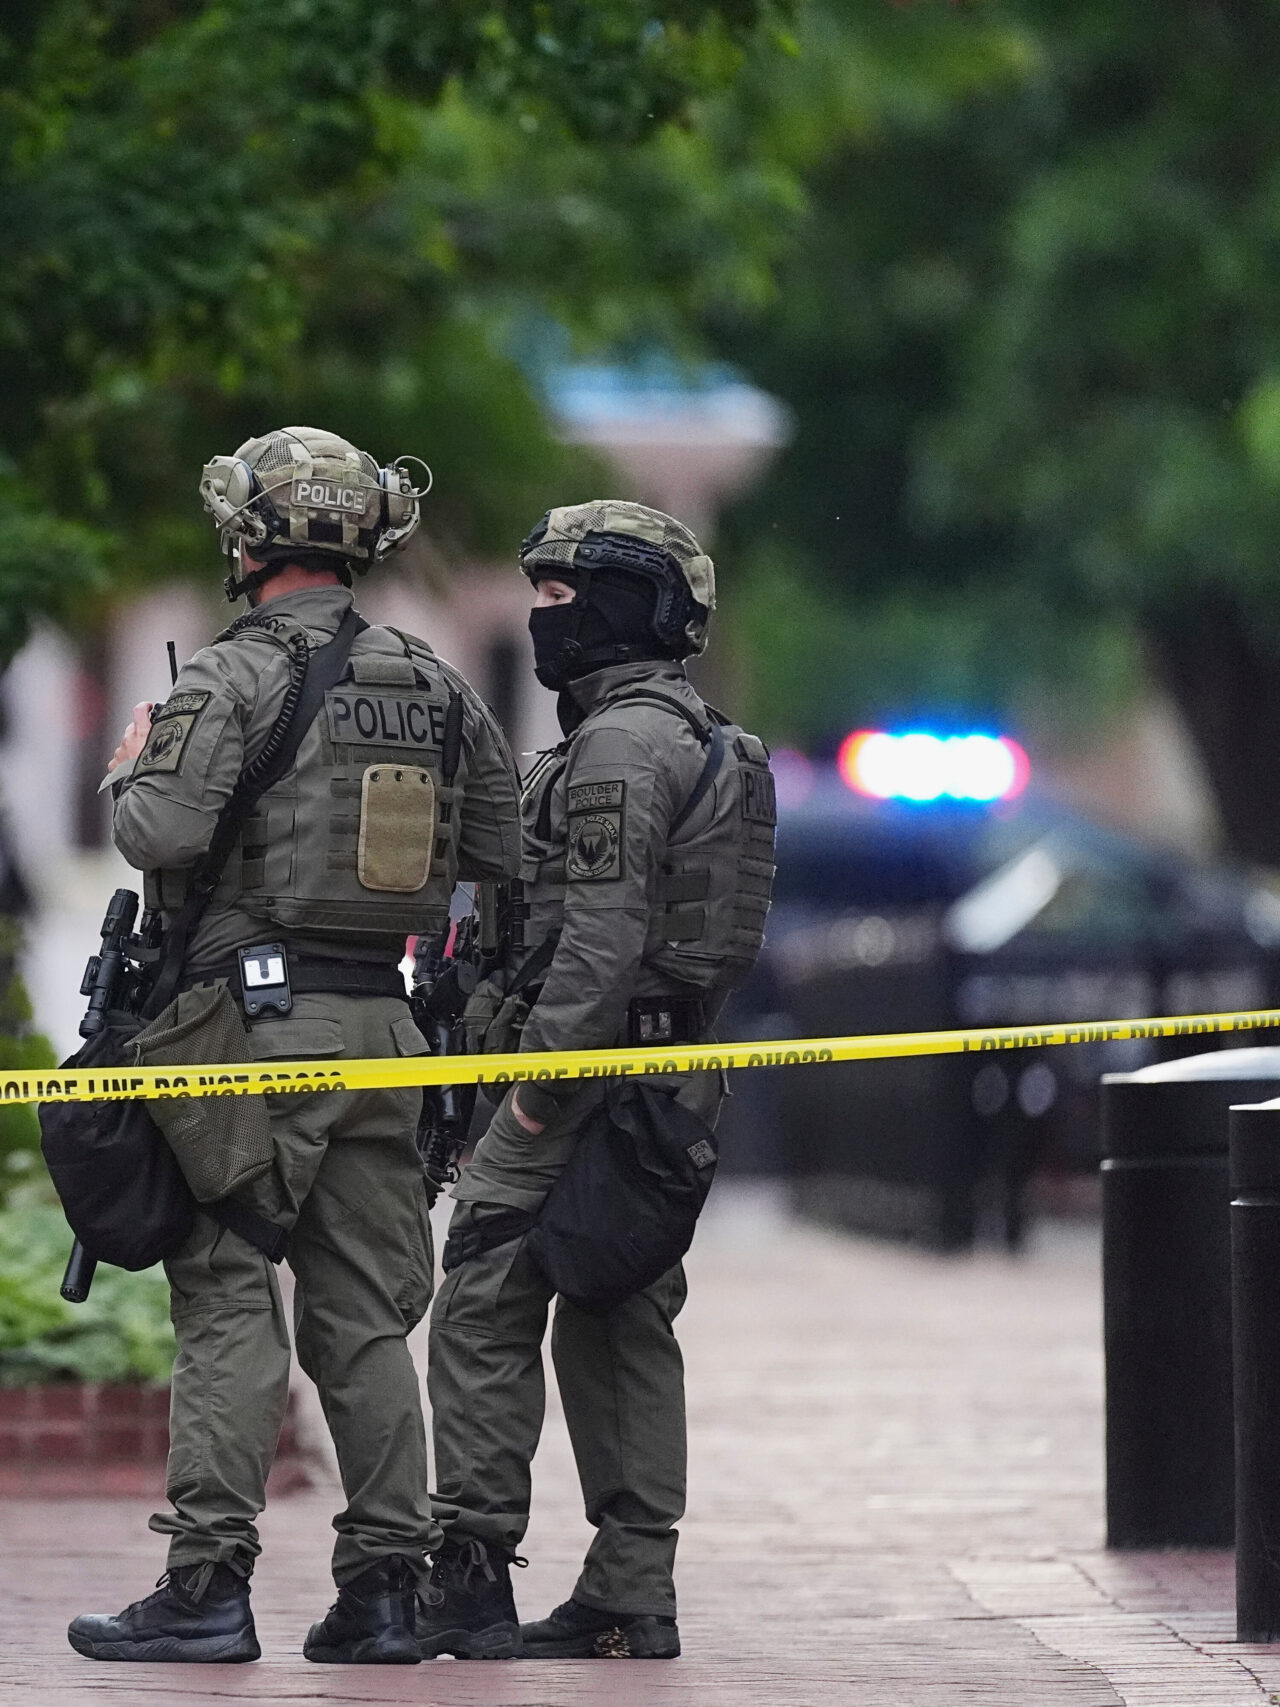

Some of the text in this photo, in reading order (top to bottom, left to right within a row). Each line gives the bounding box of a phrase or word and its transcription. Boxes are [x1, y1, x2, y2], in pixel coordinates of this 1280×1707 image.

[296, 482, 365, 510] POLICE
[331, 696, 445, 746] POLICE
[570, 783, 619, 800] BOULDER
[575, 794, 613, 809] POLICE
